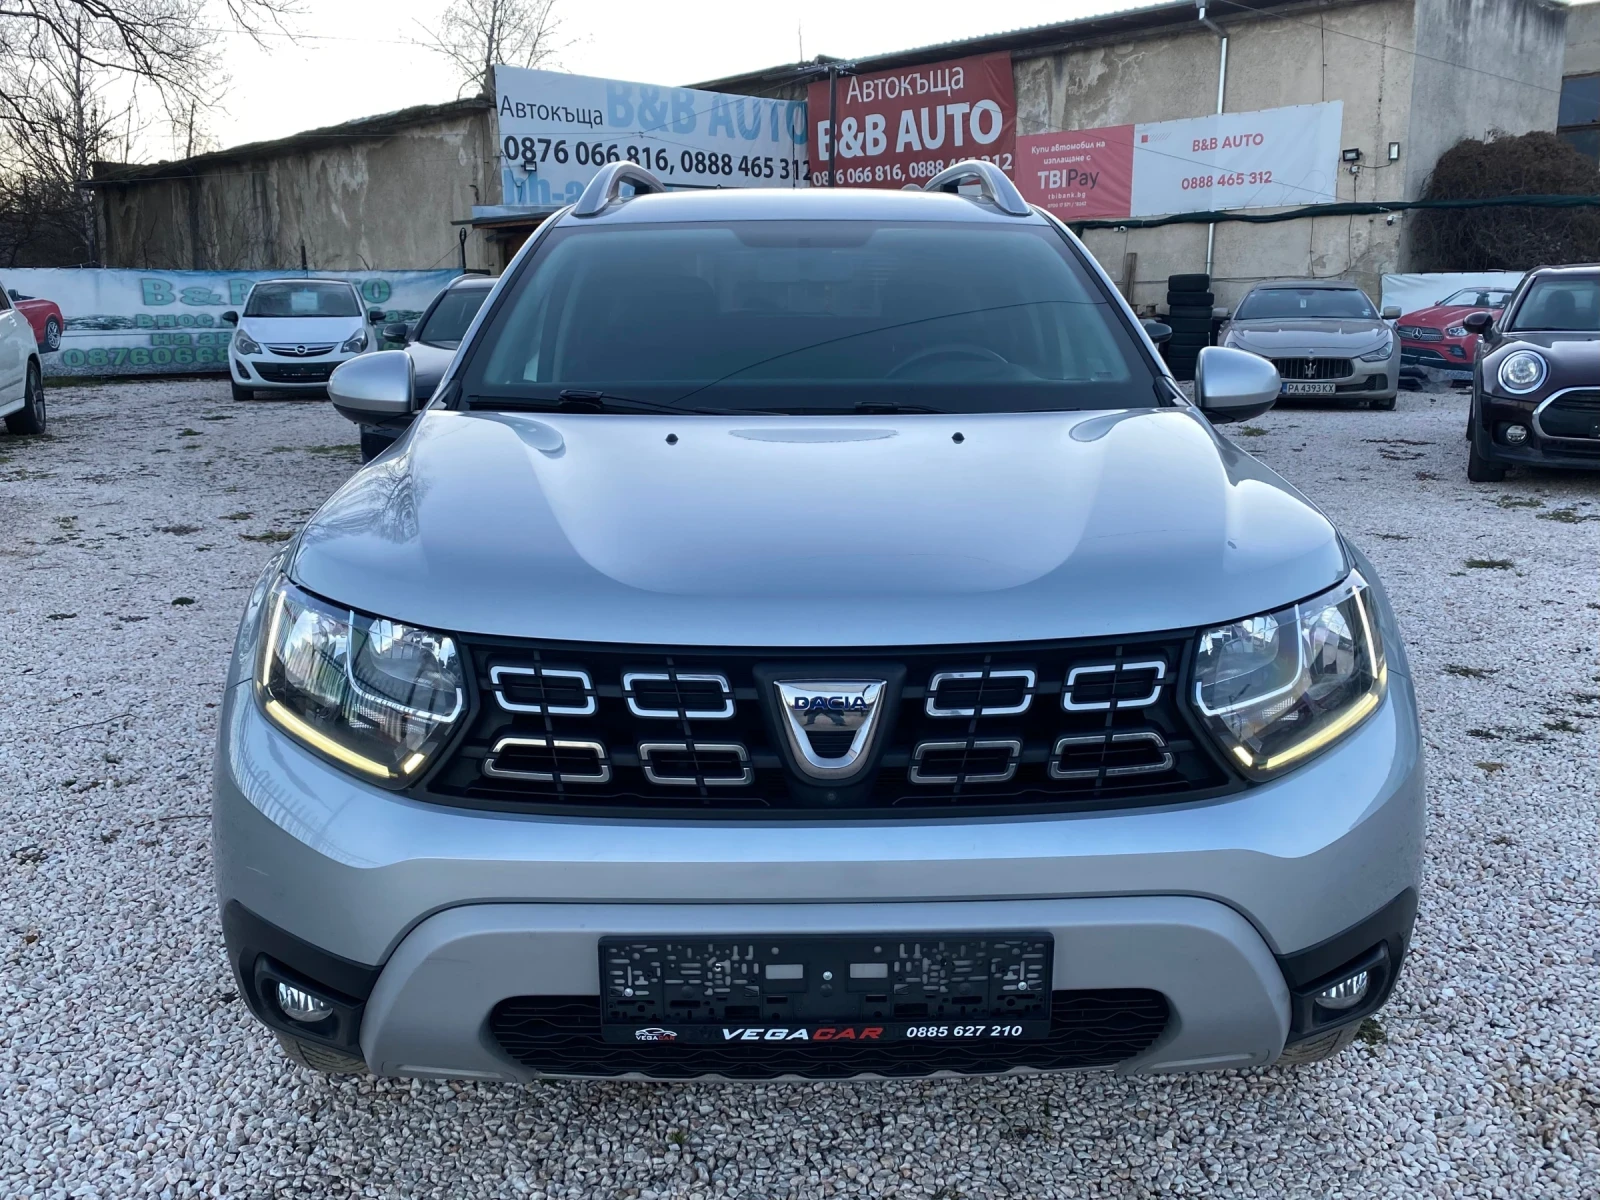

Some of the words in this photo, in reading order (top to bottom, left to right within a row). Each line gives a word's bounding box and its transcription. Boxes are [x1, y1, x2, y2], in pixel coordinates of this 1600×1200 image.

[846, 66, 964, 104] Автокъща
[500, 95, 603, 129] Автокъща
[606, 83, 697, 134] B&B
[708, 95, 808, 145] AUTO
[817, 114, 887, 161] B&B
[895, 99, 1003, 153] AUTO
[1031, 144, 1050, 155] Купи
[1051, 141, 1094, 152] автомобил
[1192, 138, 1218, 152] B&B
[1222, 133, 1264, 149] AUTO
[504, 136, 569, 164] 0876
[575, 141, 620, 167] 066
[626, 145, 675, 175] 816,
[681, 150, 732, 175] 0888
[738, 155, 774, 178] 465
[780, 157, 811, 181] 312
[1044, 155, 1085, 165] изплащане
[813, 169, 844, 186] 086
[847, 167, 872, 183] 066
[876, 164, 906, 182] 816,
[909, 160, 945, 178] 0888
[1038, 169, 1100, 190] TBIPay
[1181, 175, 1213, 190] 0888
[1217, 173, 1244, 187] 465
[1249, 171, 1272, 184] 312
[794, 696, 868, 710] DACIA
[906, 1026, 948, 1038] 0885
[953, 1026, 986, 1037] 627
[990, 1025, 1023, 1036] 210
